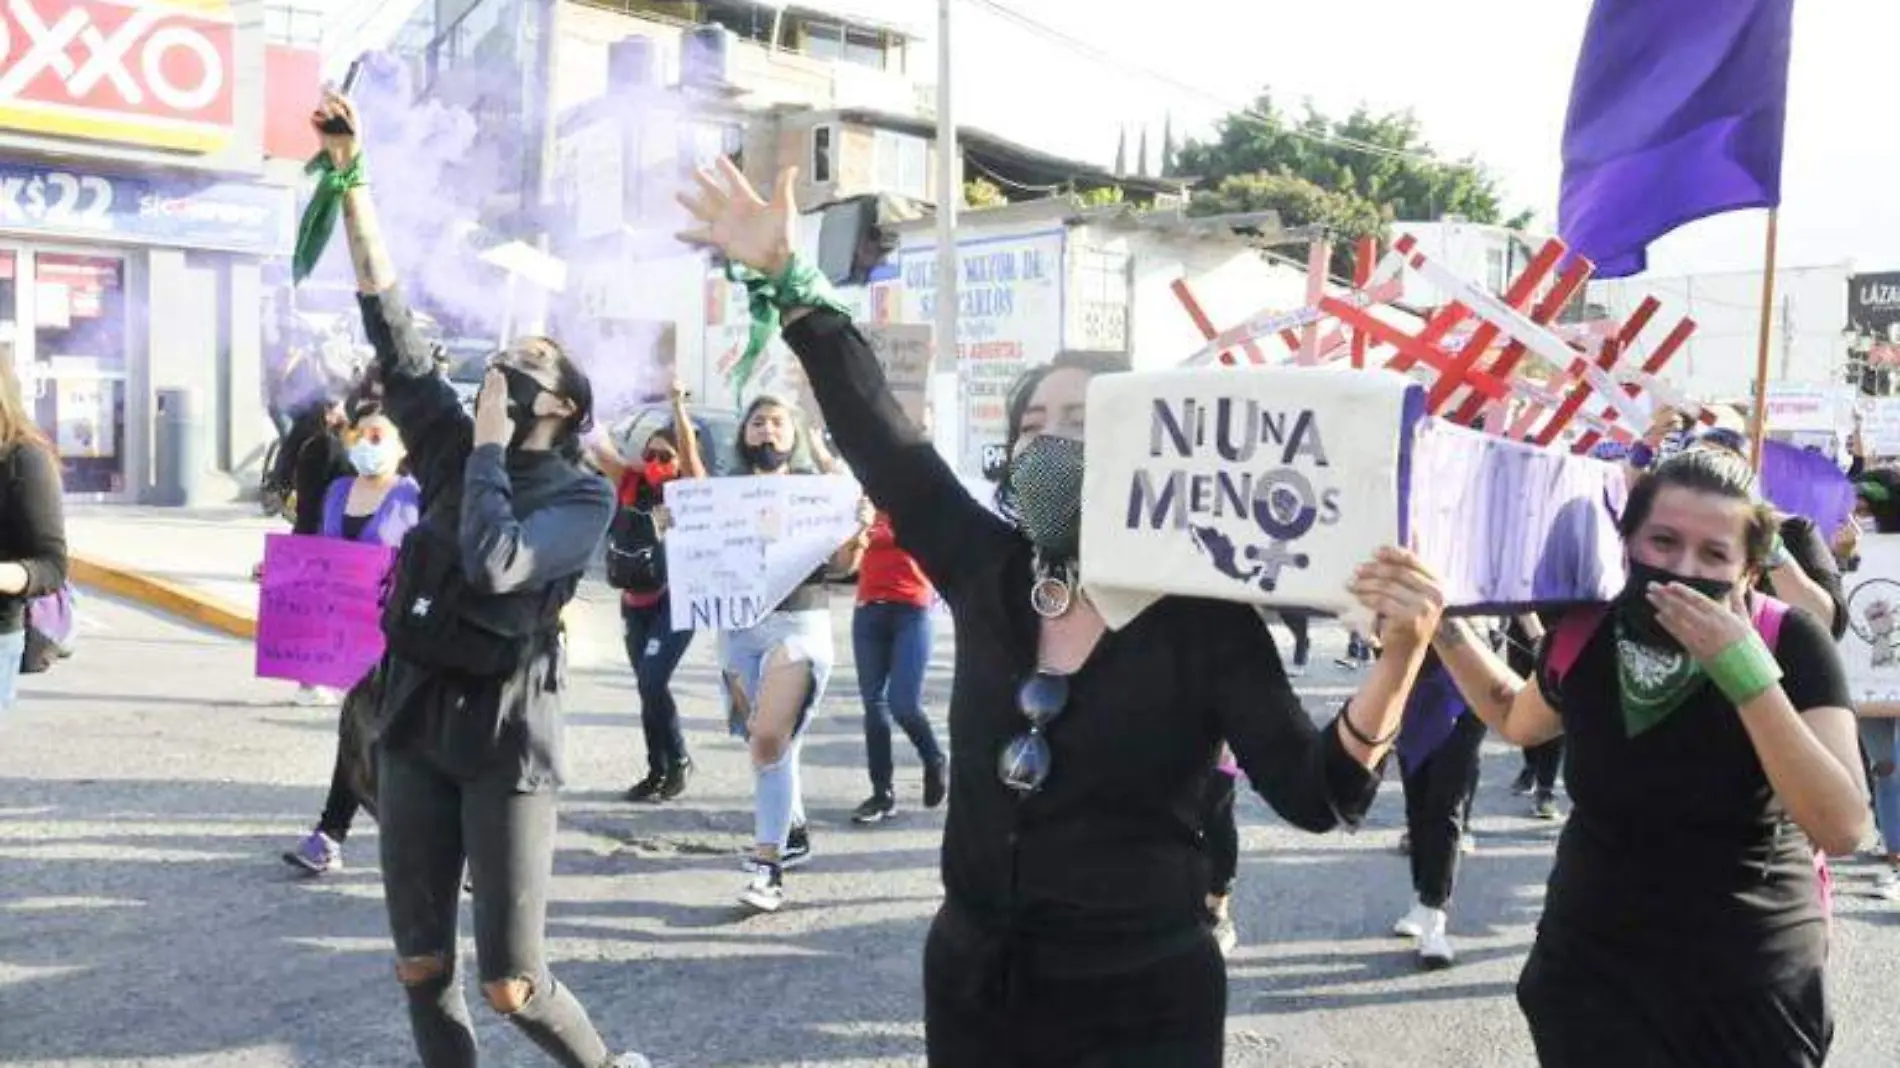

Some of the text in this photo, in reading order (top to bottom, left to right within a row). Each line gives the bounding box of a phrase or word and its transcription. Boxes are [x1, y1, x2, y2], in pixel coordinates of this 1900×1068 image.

[0, 0, 223, 110] XXO
[1149, 396, 1329, 467] NI UNA
[1125, 468, 1342, 541] MENOS
